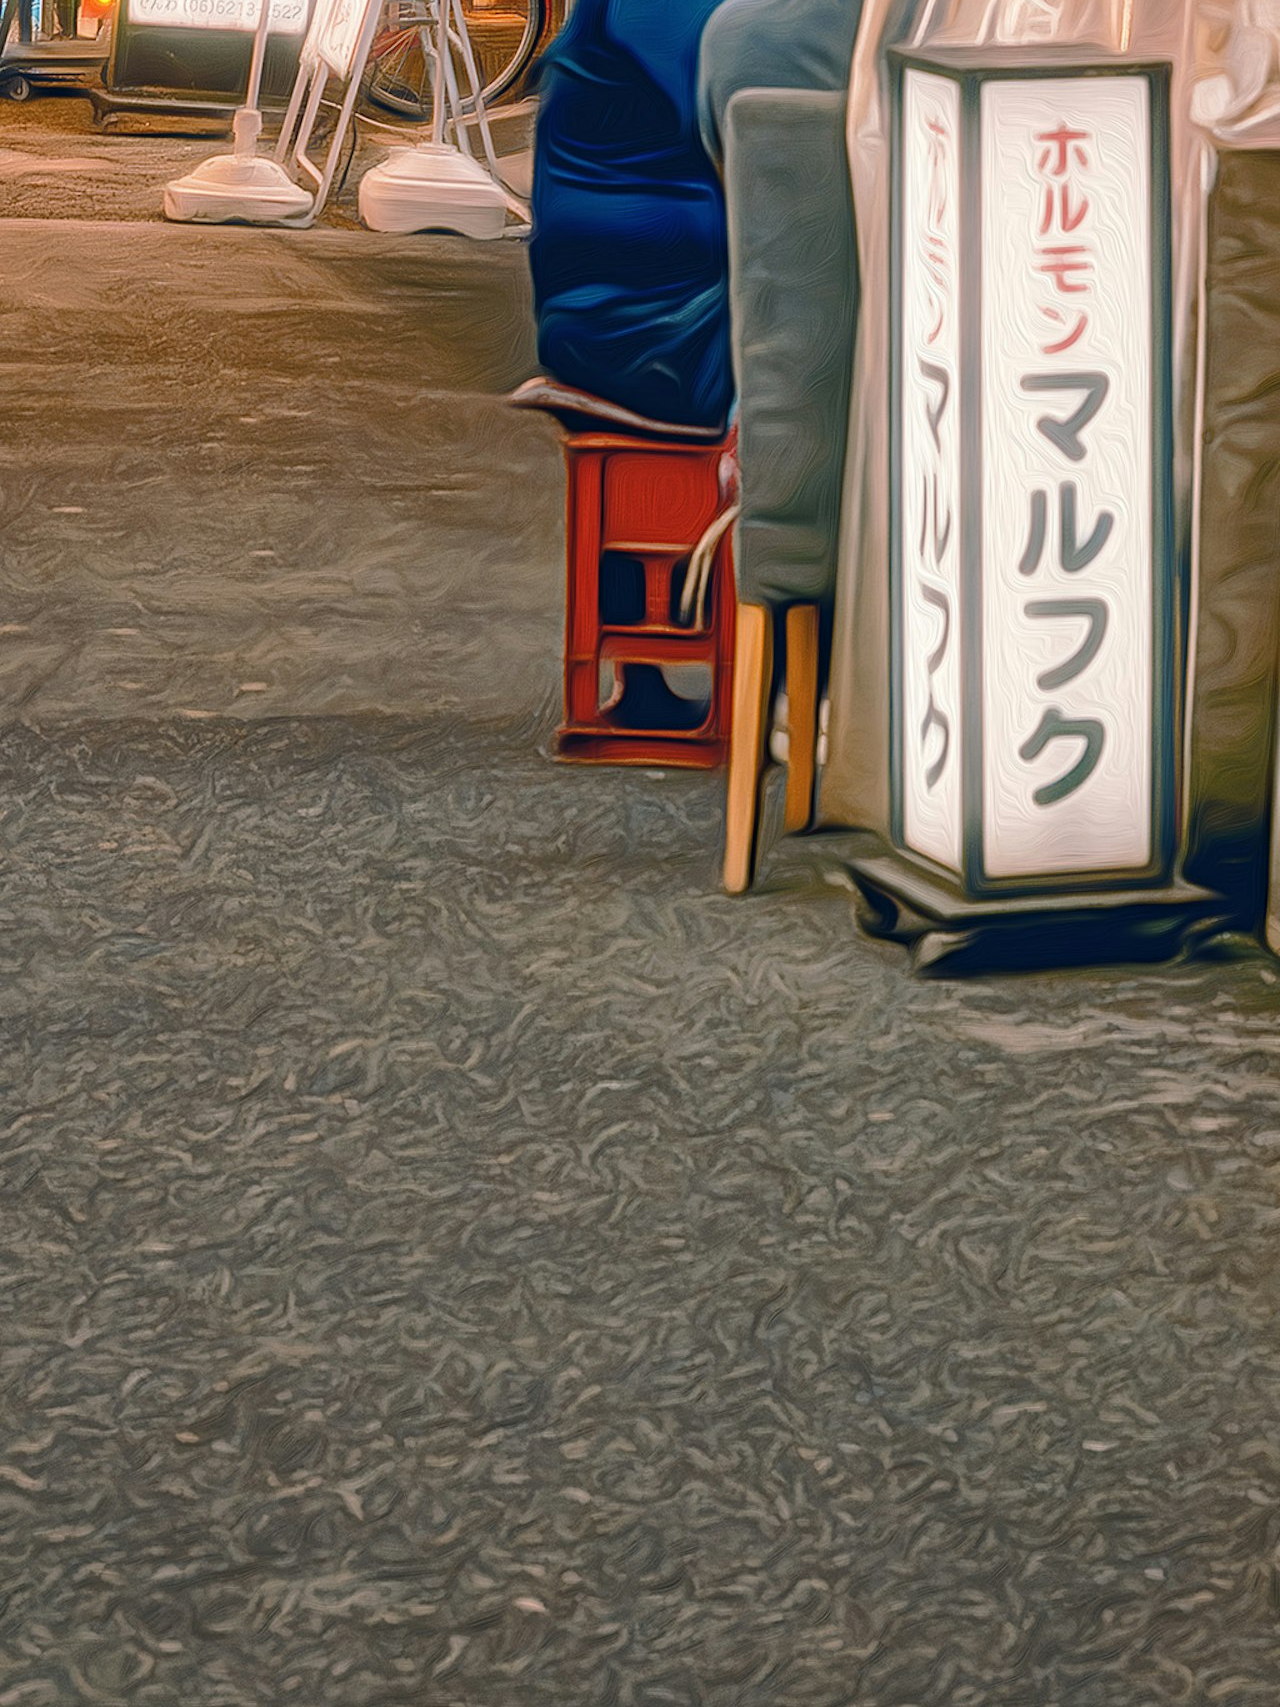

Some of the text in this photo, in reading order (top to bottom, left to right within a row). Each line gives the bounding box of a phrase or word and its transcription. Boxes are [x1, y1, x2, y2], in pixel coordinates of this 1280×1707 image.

[1035, 124, 1092, 354] ホルモン
[1019, 371, 1114, 807] マルフク
